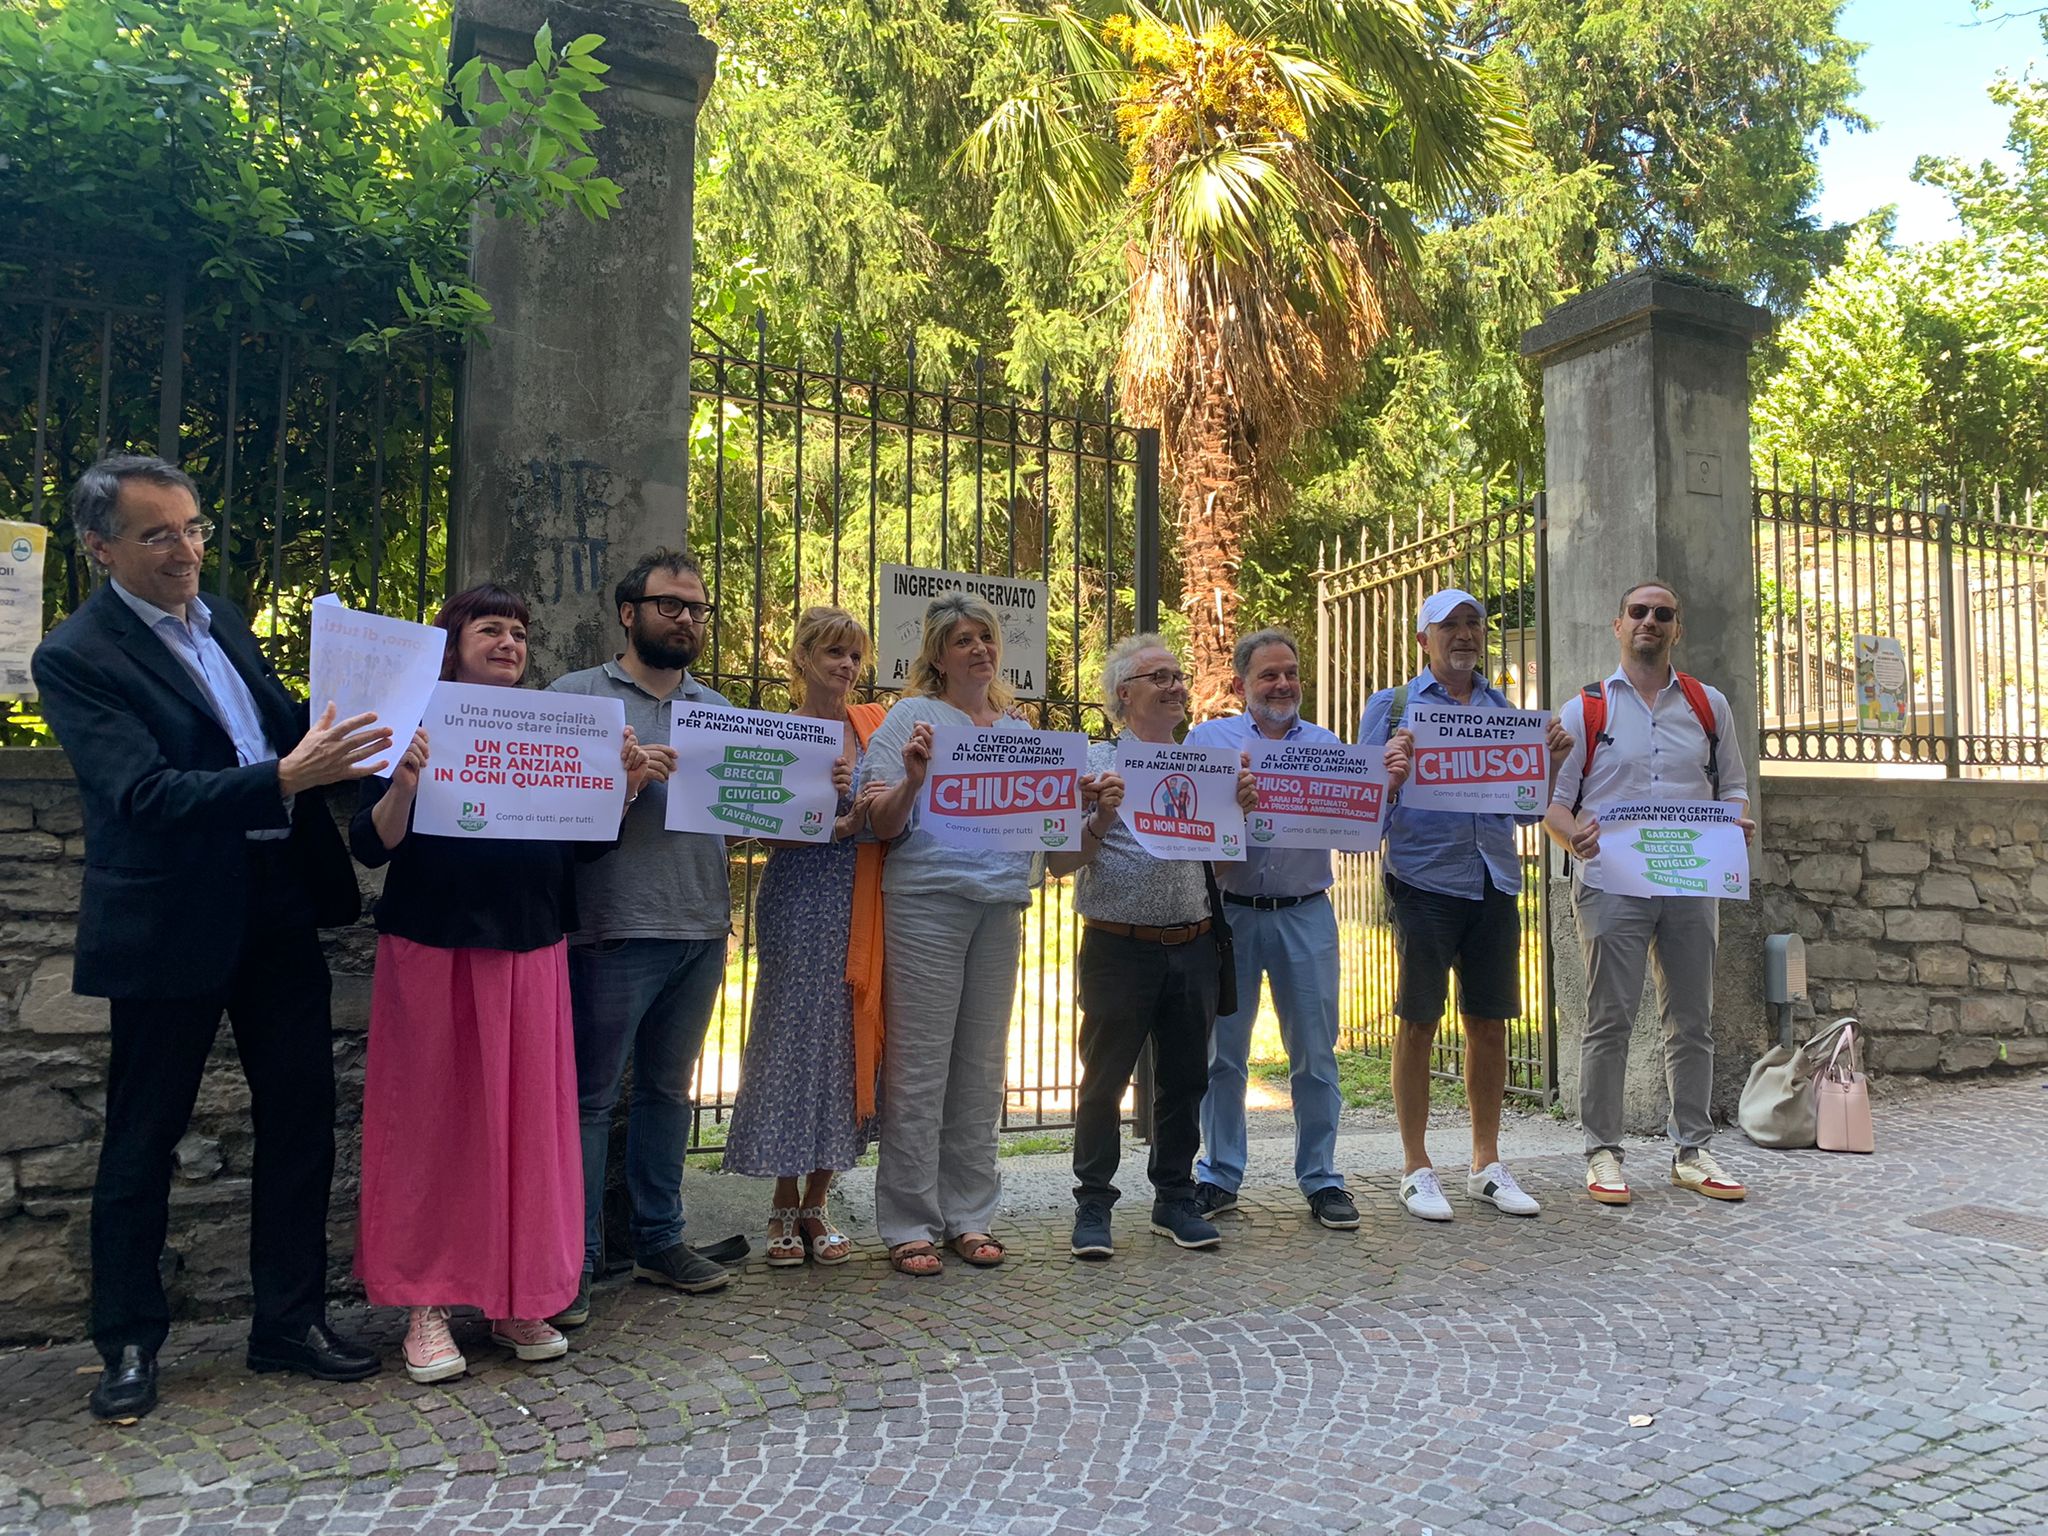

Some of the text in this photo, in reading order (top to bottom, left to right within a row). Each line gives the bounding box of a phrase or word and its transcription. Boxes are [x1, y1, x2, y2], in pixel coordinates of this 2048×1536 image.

[460, 704, 596, 725] Una nuova socialità
[1414, 712, 1542, 728] IL CENTRO ANZIANI
[445, 715, 609, 738] Un nuovo stare insieme
[688, 710, 824, 734] APRIAMO NUOVI CENTRI
[677, 718, 837, 746] PER ANZIANI NEI QUARTIERI:
[1439, 727, 1515, 739] DI ALBATE?
[978, 734, 1041, 745] CI VEDIAMO
[474, 740, 579, 758] UN CENTRO
[733, 749, 784, 763] GARZOLA
[957, 743, 1062, 756] AL CENTRO ANZIANI
[1156, 751, 1207, 761] AL CENTRO
[1298, 748, 1345, 757] VEDIAMO
[465, 755, 582, 773] PER ANZIANI
[952, 753, 1065, 765] DI MONTE OLIMPINO?
[1281, 755, 1321, 763] CENTRO
[1324, 758, 1366, 766] ANZIANI
[1418, 747, 1539, 780] CHIUSO!
[724, 767, 775, 781] BRECCIA
[1125, 760, 1144, 768] PER
[1146, 761, 1184, 771] ANZIANI
[1198, 765, 1235, 774] ALBATE:
[1274, 763, 1309, 771] MONTE
[1312, 765, 1368, 774] OLIMPINO?
[434, 768, 614, 790] IN OGNI QUARTIERE
[725, 789, 780, 801] CIVIGLIO
[936, 776, 1071, 810] CHIUSO!
[1255, 776, 1379, 803] HIUSO, RITENTA!
[1307, 798, 1348, 807] FORTUNATO
[1271, 803, 1308, 812] PROSSIMA
[1310, 806, 1376, 818] AMMINISTRAZIONE
[1609, 806, 1650, 814] APRIAMO
[1688, 807, 1724, 815] CENTRI
[496, 813, 523, 822] Como
[560, 816, 574, 824] per
[721, 807, 777, 829] TAVERNOLA
[1679, 814, 1735, 823] QUARTIERI:
[945, 822, 970, 832] Como
[1140, 818, 1211, 836] IO NON ENTRO
[1646, 830, 1690, 839] GARZOLA
[1644, 844, 1688, 853] BRECCIA
[1651, 859, 1697, 868] CIVIGLIO
[1654, 874, 1703, 888] TAVERNOLA
